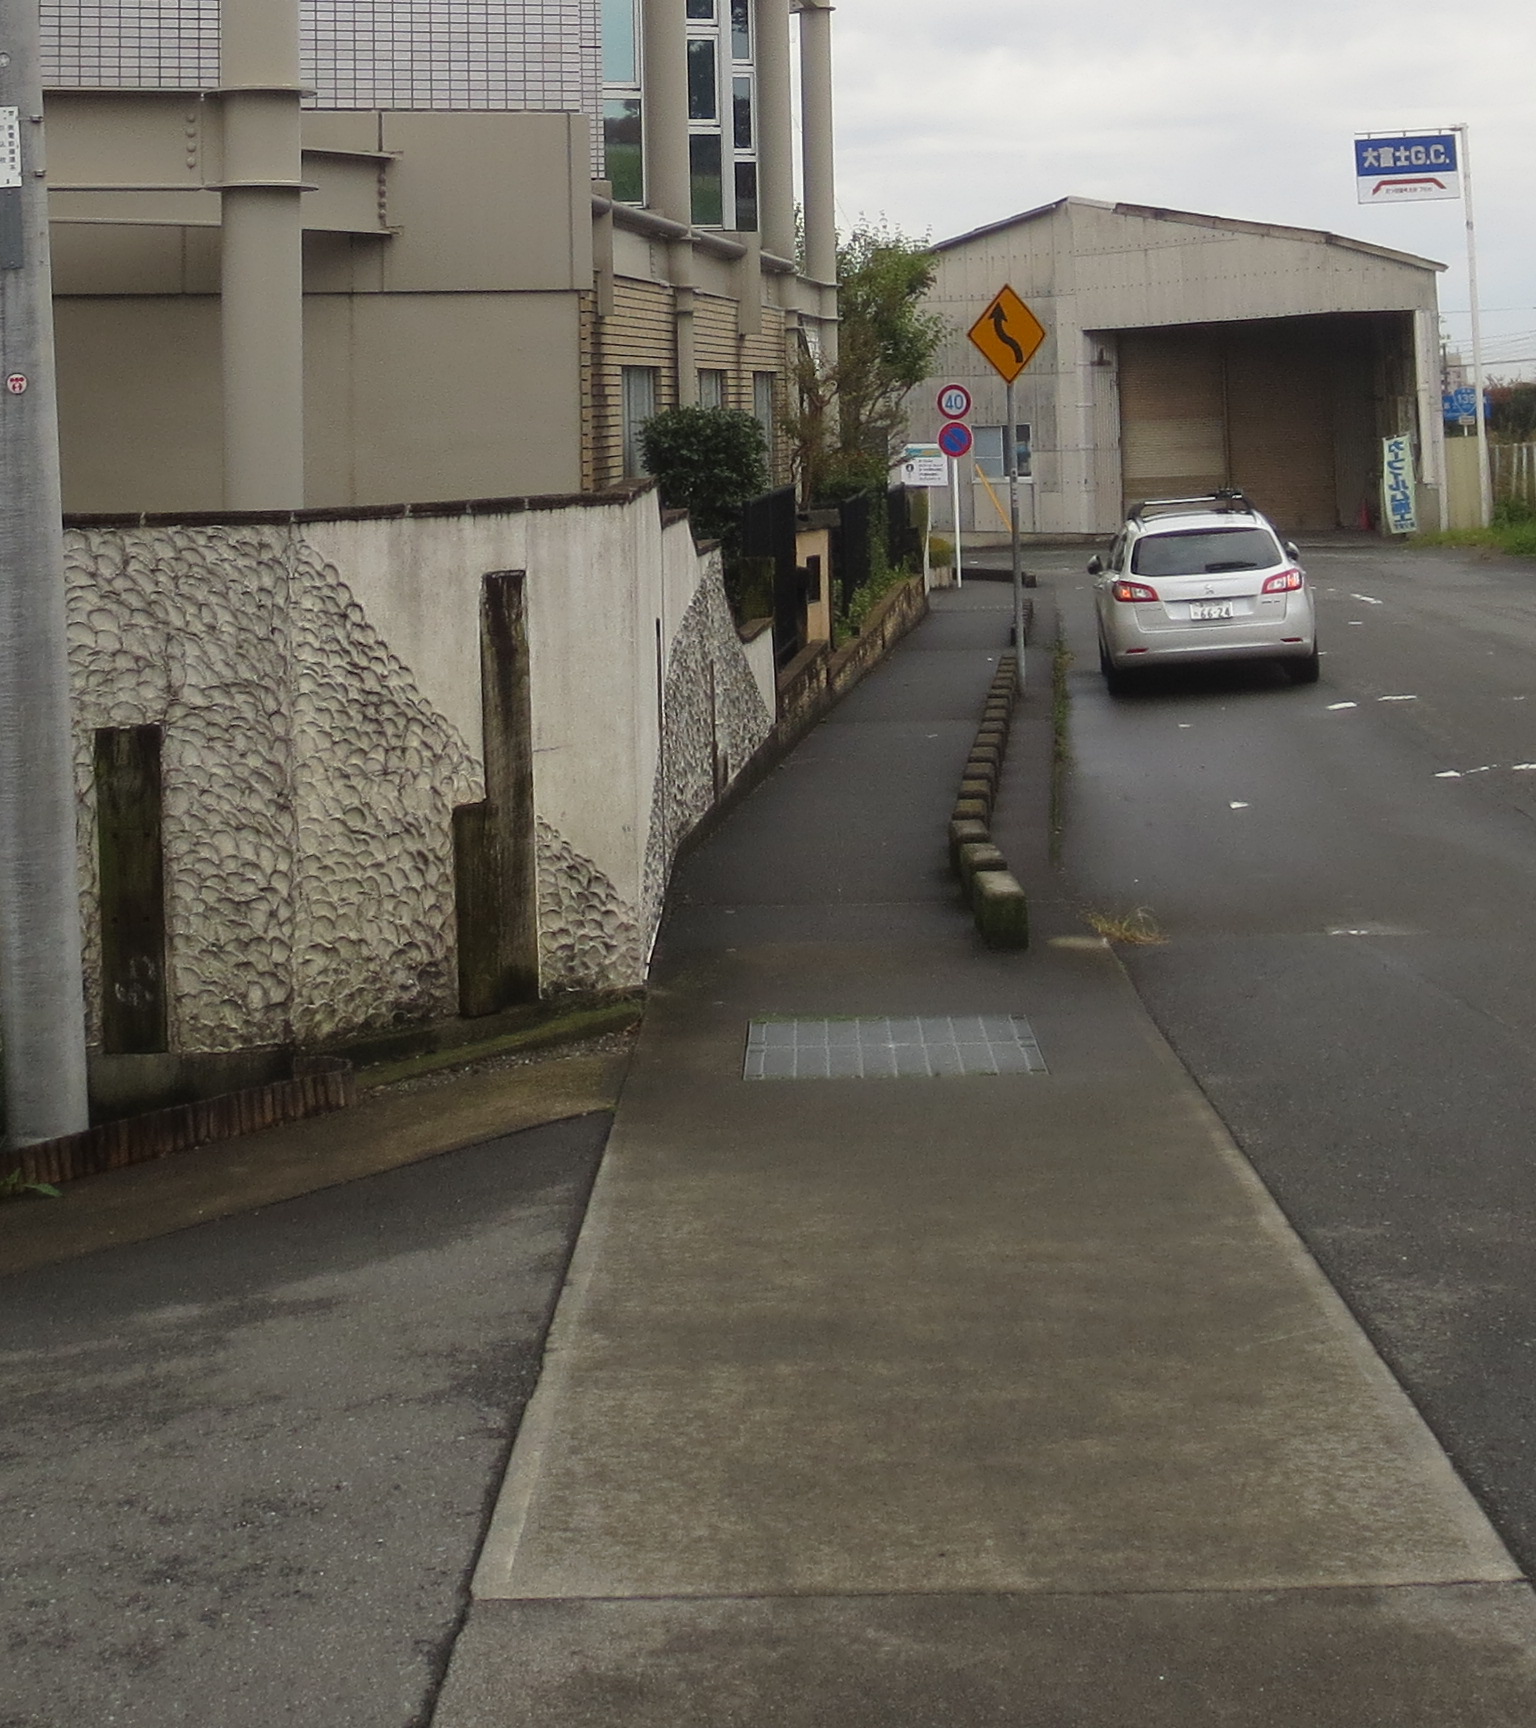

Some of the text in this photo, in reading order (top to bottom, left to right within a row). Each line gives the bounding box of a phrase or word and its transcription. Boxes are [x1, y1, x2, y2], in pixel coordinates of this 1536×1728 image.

[1362, 144, 1451, 169] 大富士G.C.
[945, 394, 964, 410] 40
